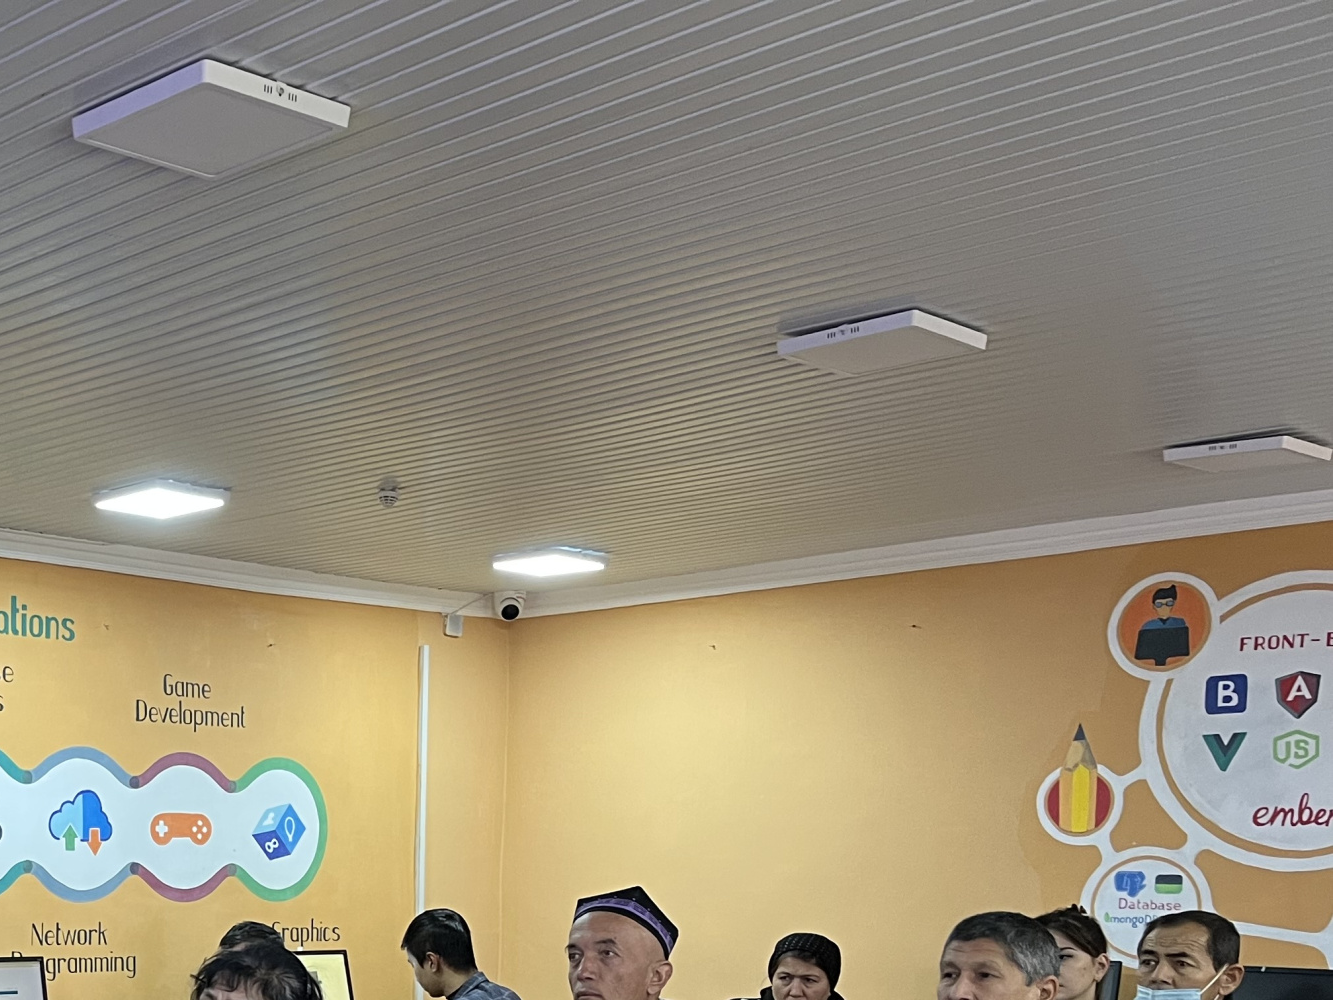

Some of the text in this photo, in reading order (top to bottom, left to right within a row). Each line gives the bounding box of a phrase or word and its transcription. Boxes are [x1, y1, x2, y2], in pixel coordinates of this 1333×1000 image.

[163, 673, 212, 700] Game
[135, 699, 246, 733] Development
[1118, 897, 1182, 911] Database
[30, 921, 108, 947] Network
[12, 951, 137, 981] gramming
